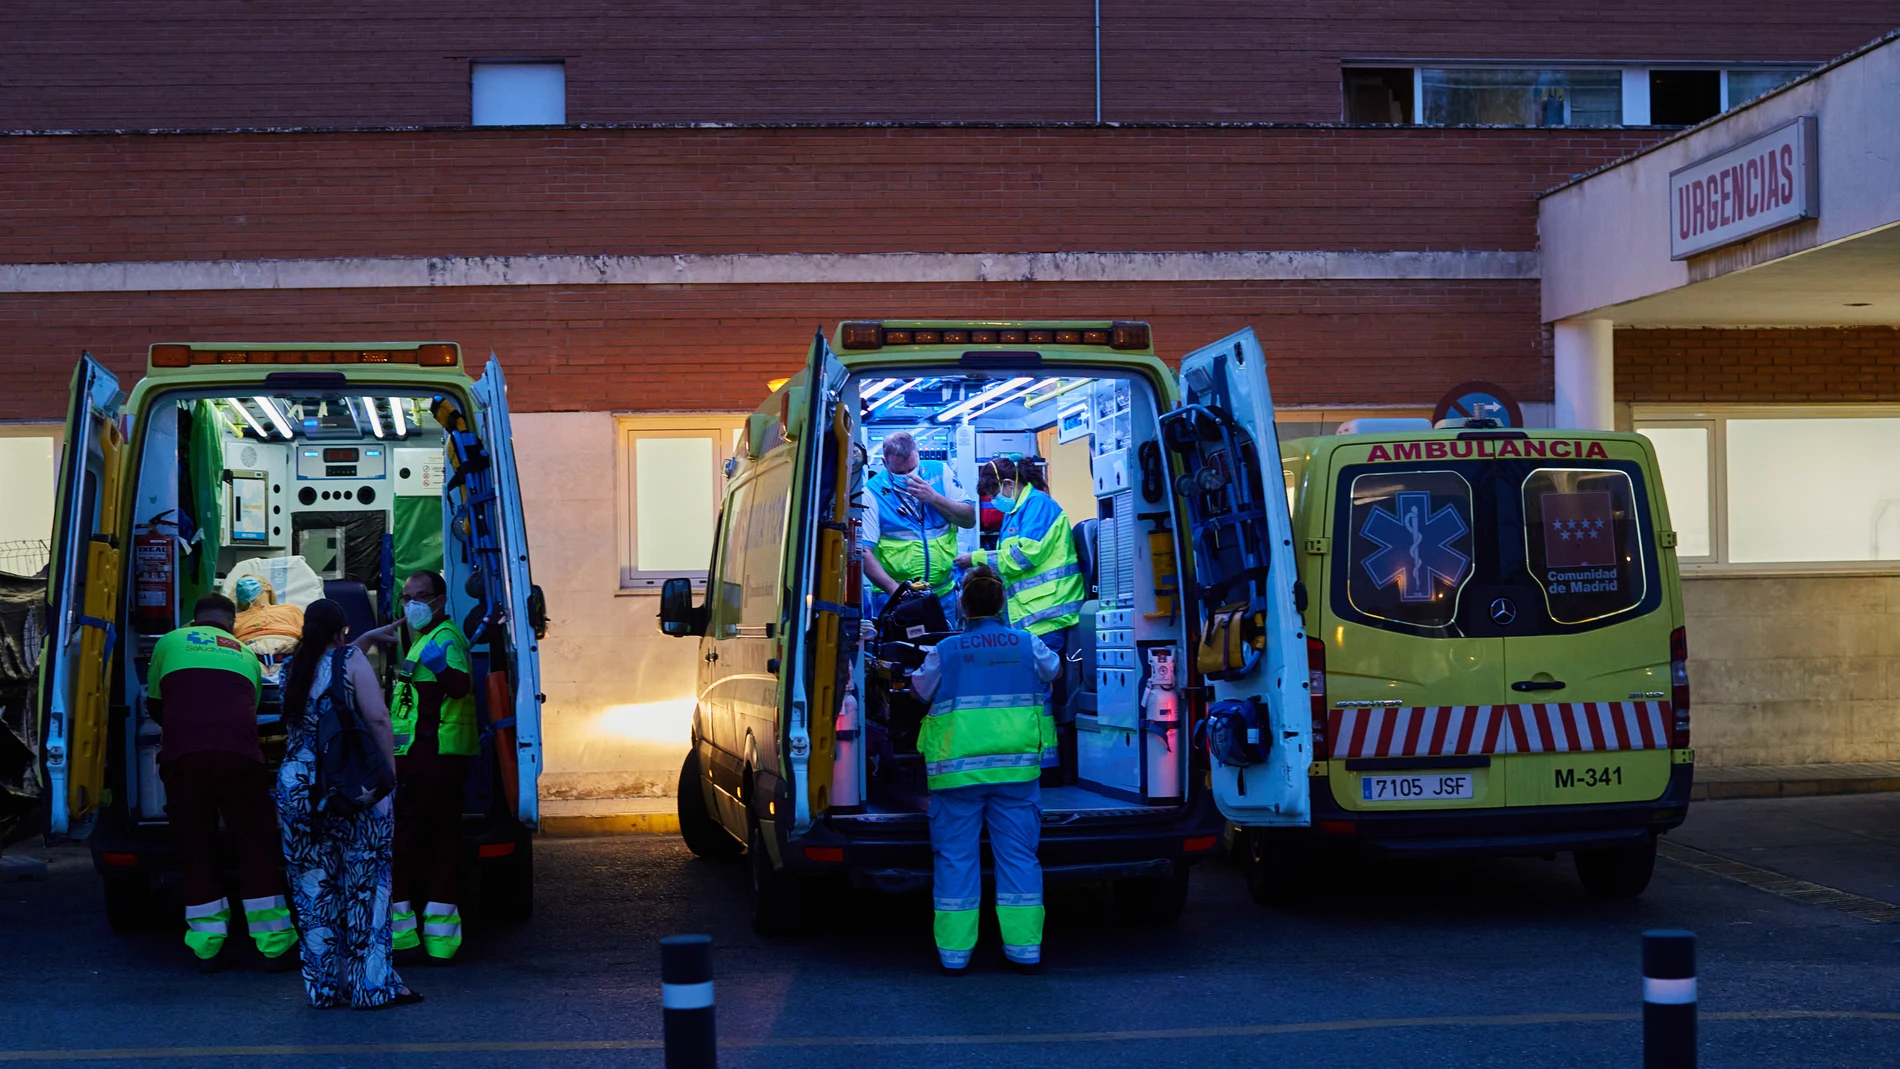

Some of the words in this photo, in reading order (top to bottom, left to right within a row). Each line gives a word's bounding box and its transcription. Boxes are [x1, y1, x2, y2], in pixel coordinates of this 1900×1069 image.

[1679, 143, 1793, 240] URGENCIAS
[1366, 440, 1609, 462] AMBULANCIA
[1547, 568, 1617, 581] Comunidad
[1548, 582, 1566, 594] de
[1570, 580, 1618, 593] Madrid
[1376, 778, 1423, 798] 7105
[1433, 777, 1466, 795] JSF
[1554, 766, 1623, 788] M-341
